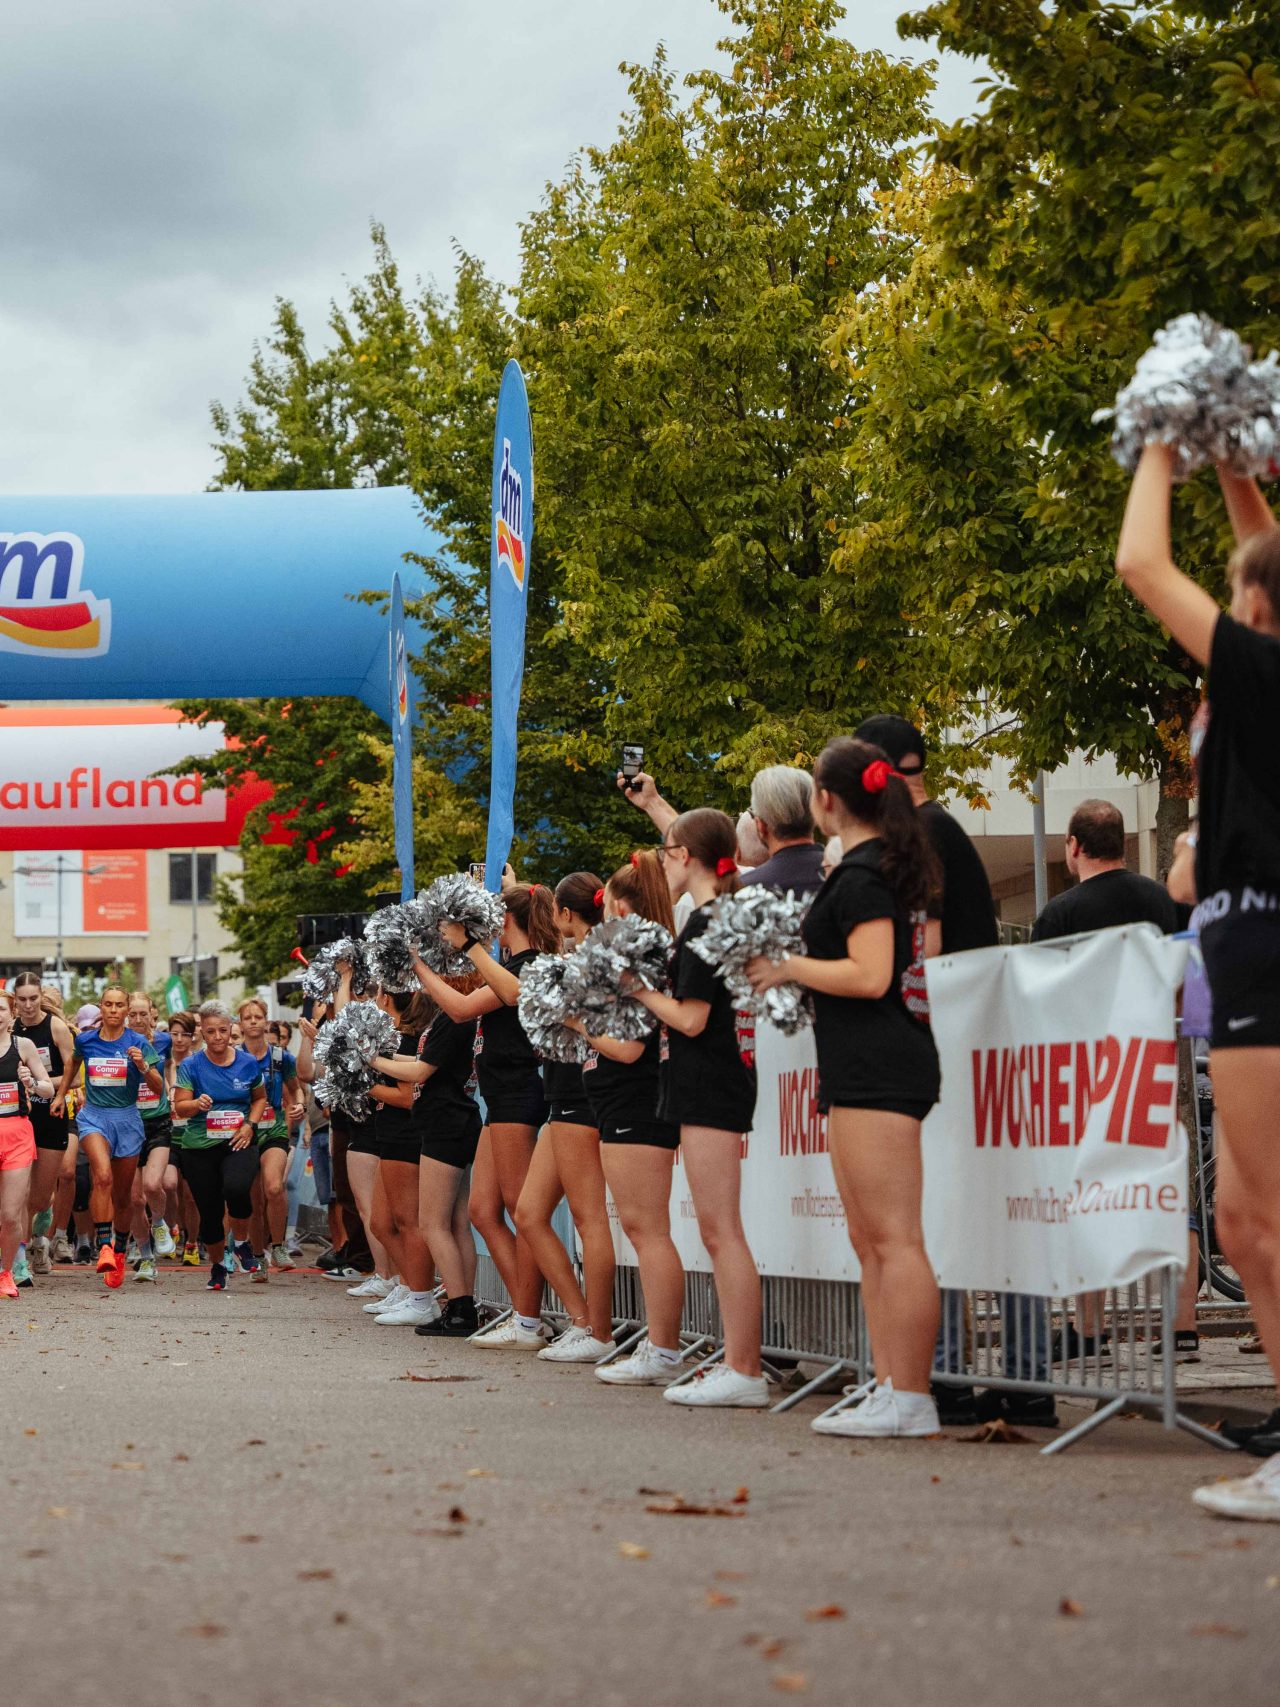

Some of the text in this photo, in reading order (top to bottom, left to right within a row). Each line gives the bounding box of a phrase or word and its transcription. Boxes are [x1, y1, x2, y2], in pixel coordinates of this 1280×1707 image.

[501, 446, 521, 536] dm
[95, 1066, 119, 1074] Conny
[211, 1117, 239, 1125] Jessica
